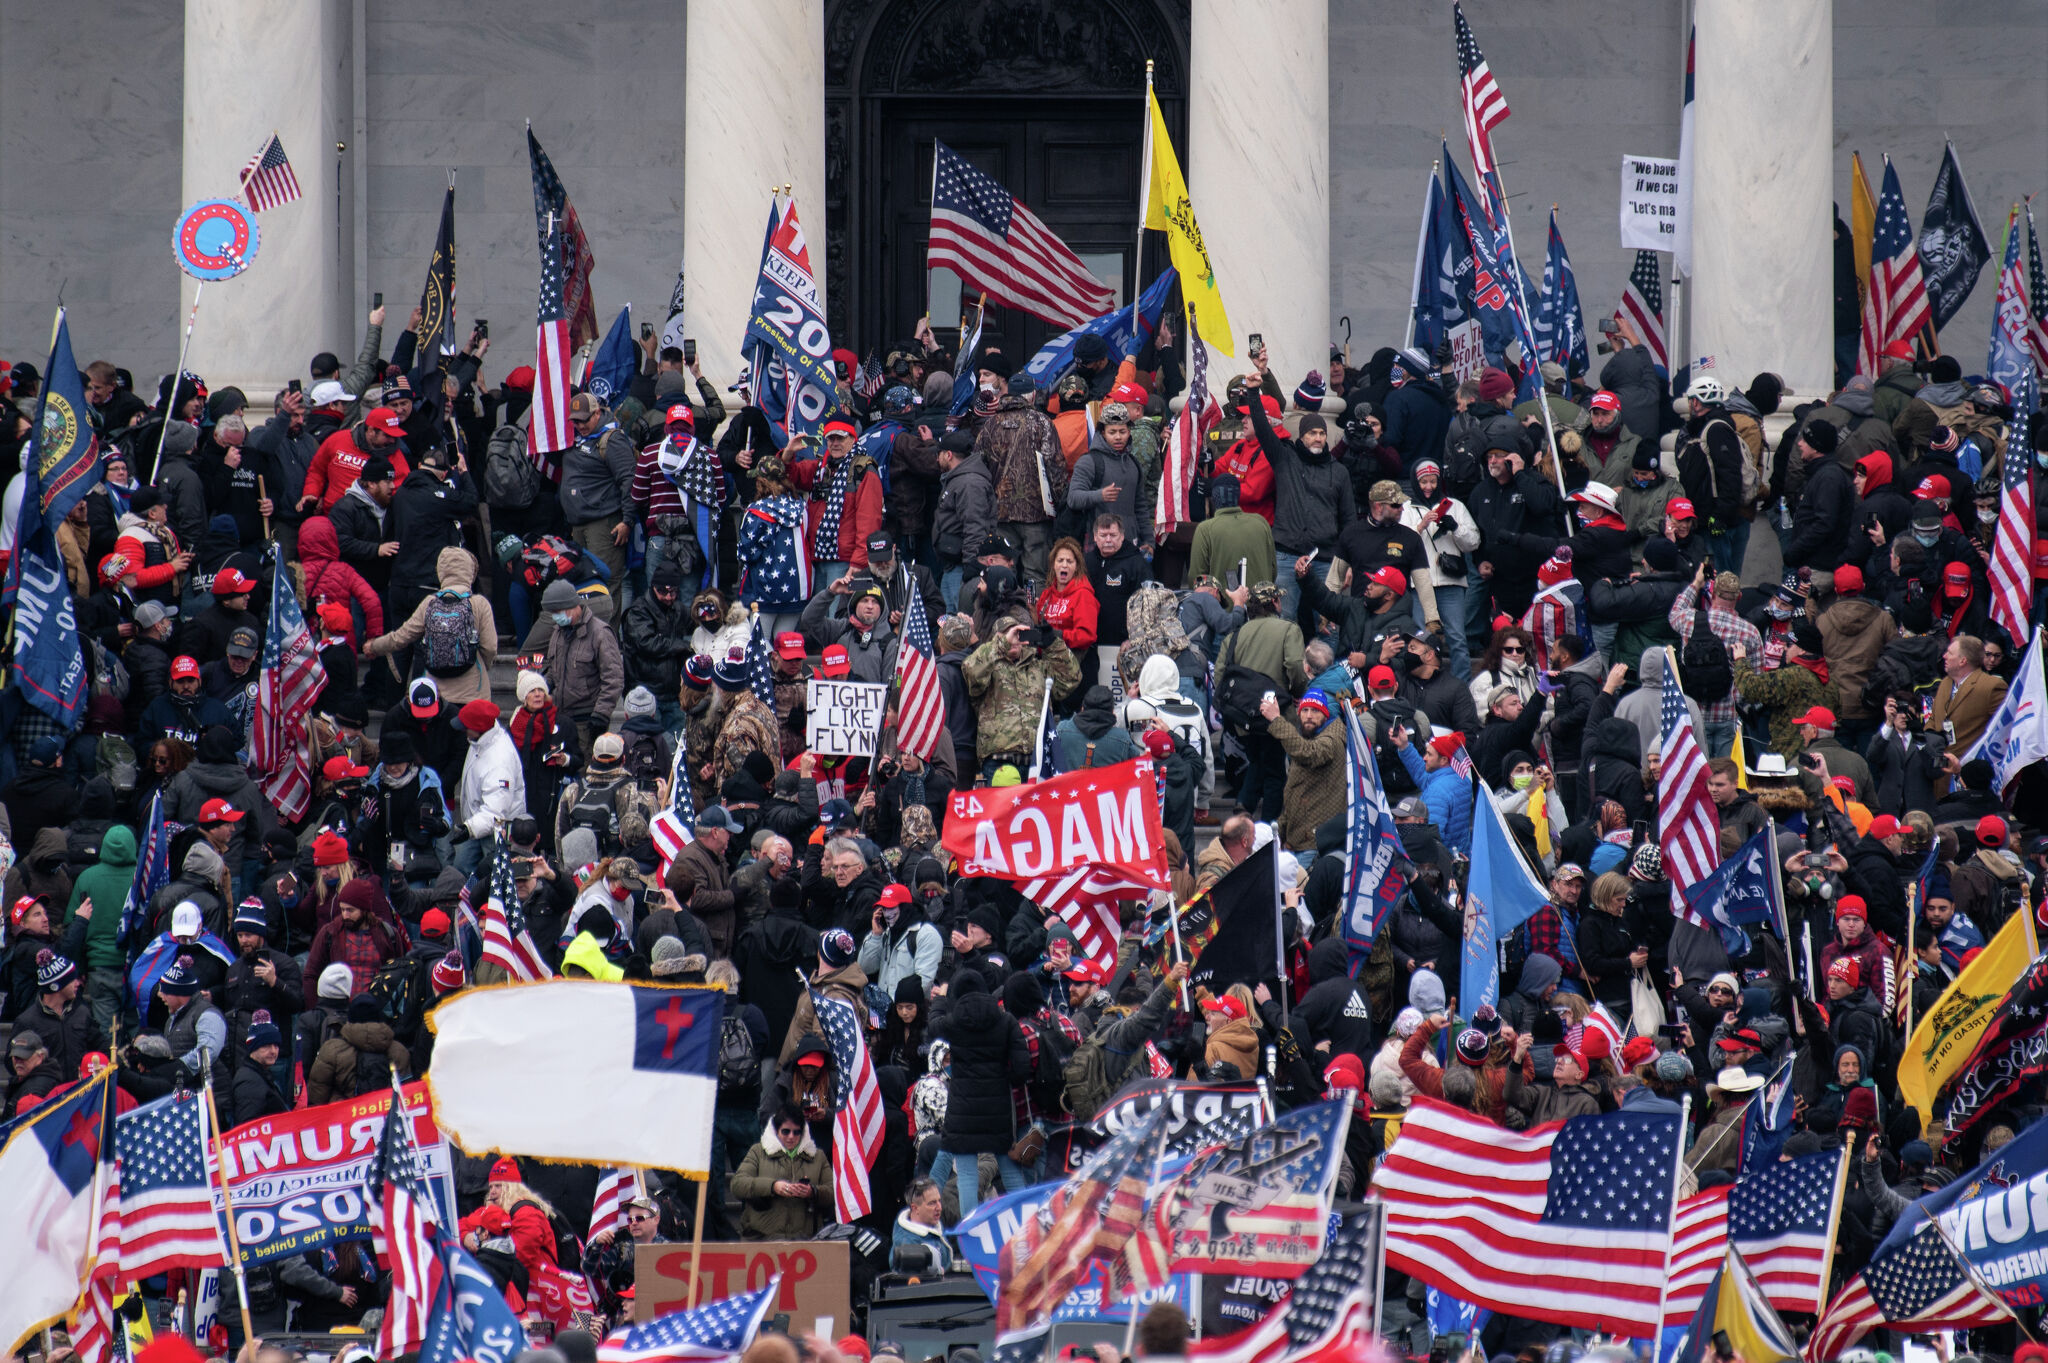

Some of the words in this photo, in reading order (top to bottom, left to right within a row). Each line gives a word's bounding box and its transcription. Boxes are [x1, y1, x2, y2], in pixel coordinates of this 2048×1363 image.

[1654, 163, 1676, 177] have
[1635, 179, 1644, 193] if
[1645, 181, 1660, 193] we
[1662, 182, 1677, 195] ca
[1453, 333, 1466, 352] WE
[1472, 325, 1483, 344] TH
[799, 353, 814, 368] Of
[1453, 343, 1484, 370] PEOPL
[815, 684, 883, 710] FIGHT
[828, 707, 874, 730] LIKE
[815, 728, 879, 754] FLYNN
[653, 1248, 817, 1319] STOP
